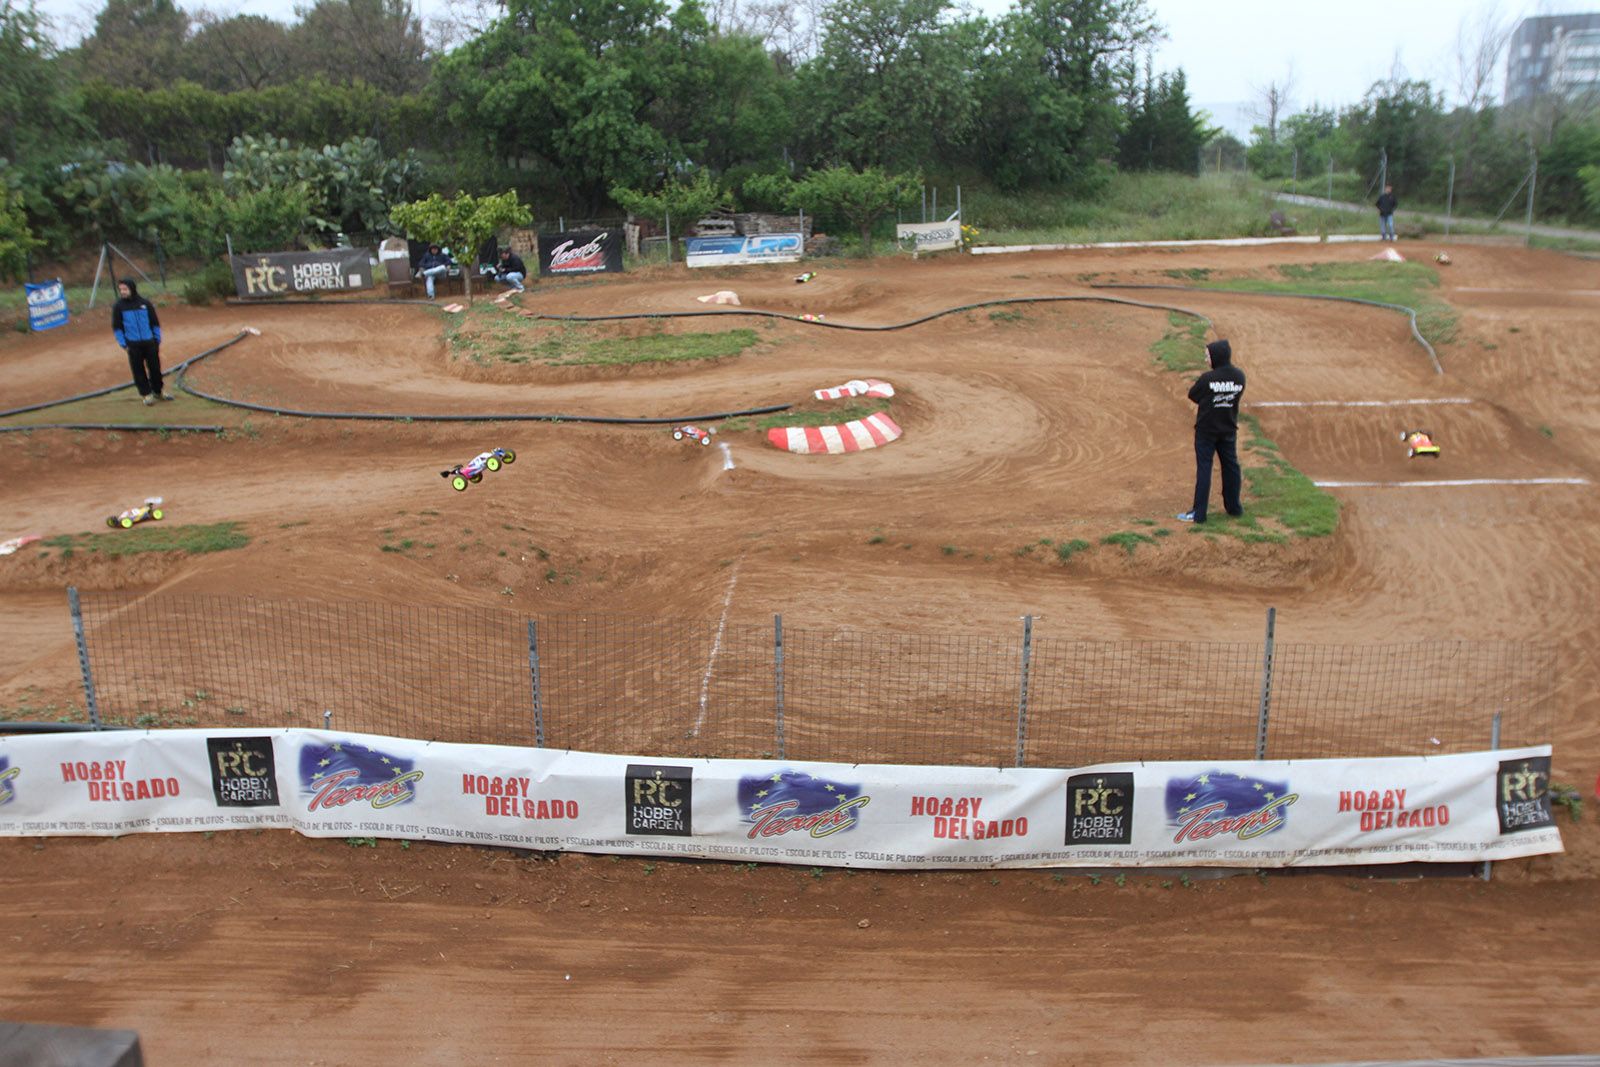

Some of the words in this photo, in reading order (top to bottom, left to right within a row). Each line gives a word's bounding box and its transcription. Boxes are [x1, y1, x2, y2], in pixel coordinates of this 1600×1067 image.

[245, 266, 288, 294] RC
[292, 262, 342, 278] HOBBY
[294, 276, 345, 291] GARDEN
[60, 760, 126, 782] HOBBY
[216, 750, 268, 777] RC
[87, 777, 180, 801] DELGADO
[220, 777, 269, 792] HOBBY
[221, 789, 272, 801] GARDEN
[462, 773, 530, 797] HOBBY
[633, 779, 682, 807] RC
[486, 796, 579, 819] DELGADO
[910, 796, 983, 818] HOBBY
[1074, 788, 1124, 816] RC
[1338, 788, 1407, 813] HOBBY
[633, 806, 682, 820] HOBBY
[633, 818, 684, 831] GARDEN
[1073, 815, 1124, 829] HOBBY
[1360, 805, 1450, 832] DELGADO
[194, 816, 224, 825] PILOTOS
[230, 815, 254, 824] ESCOLA
[312, 822, 320, 830] DE
[322, 821, 353, 831] PILOTOS
[360, 821, 385, 831] ESCOLA
[386, 823, 394, 832] DE
[395, 823, 419, 834] PILOTS
[427, 826, 455, 837] ESCUELA
[456, 829, 463, 838] DE
[465, 830, 494, 841] PILOTOS
[500, 834, 525, 843] ESCOLA
[525, 836, 533, 844] DE
[535, 836, 560, 845] PILOTS
[566, 836, 595, 846] ESCUELA
[596, 839, 604, 847] DE
[605, 839, 635, 849] PILOTOS
[641, 841, 666, 850] ESCOLA
[667, 843, 675, 851] DE
[677, 843, 702, 853] PILOTS
[709, 845, 739, 854] ESCUELA
[740, 846, 748, 855] DE
[750, 847, 779, 857] PILOTOS
[785, 848, 811, 857] ESCOLA
[812, 850, 820, 858] DE
[822, 850, 847, 859] PILOTS
[855, 851, 885, 862] ESCUELA
[886, 854, 894, 862] DE
[896, 854, 925, 863] PILOTOS
[932, 855, 958, 864] ESCOLA
[959, 855, 967, 863] DE
[969, 855, 994, 863] PILOTS
[1041, 851, 1070, 860] PILOTOS
[1077, 850, 1102, 859] ESCOLA
[1113, 851, 1138, 860] PILOTS
[1224, 850, 1250, 858] ESCOLA
[933, 817, 1028, 840] DELGADO
[1072, 827, 1124, 839] GARDEN
